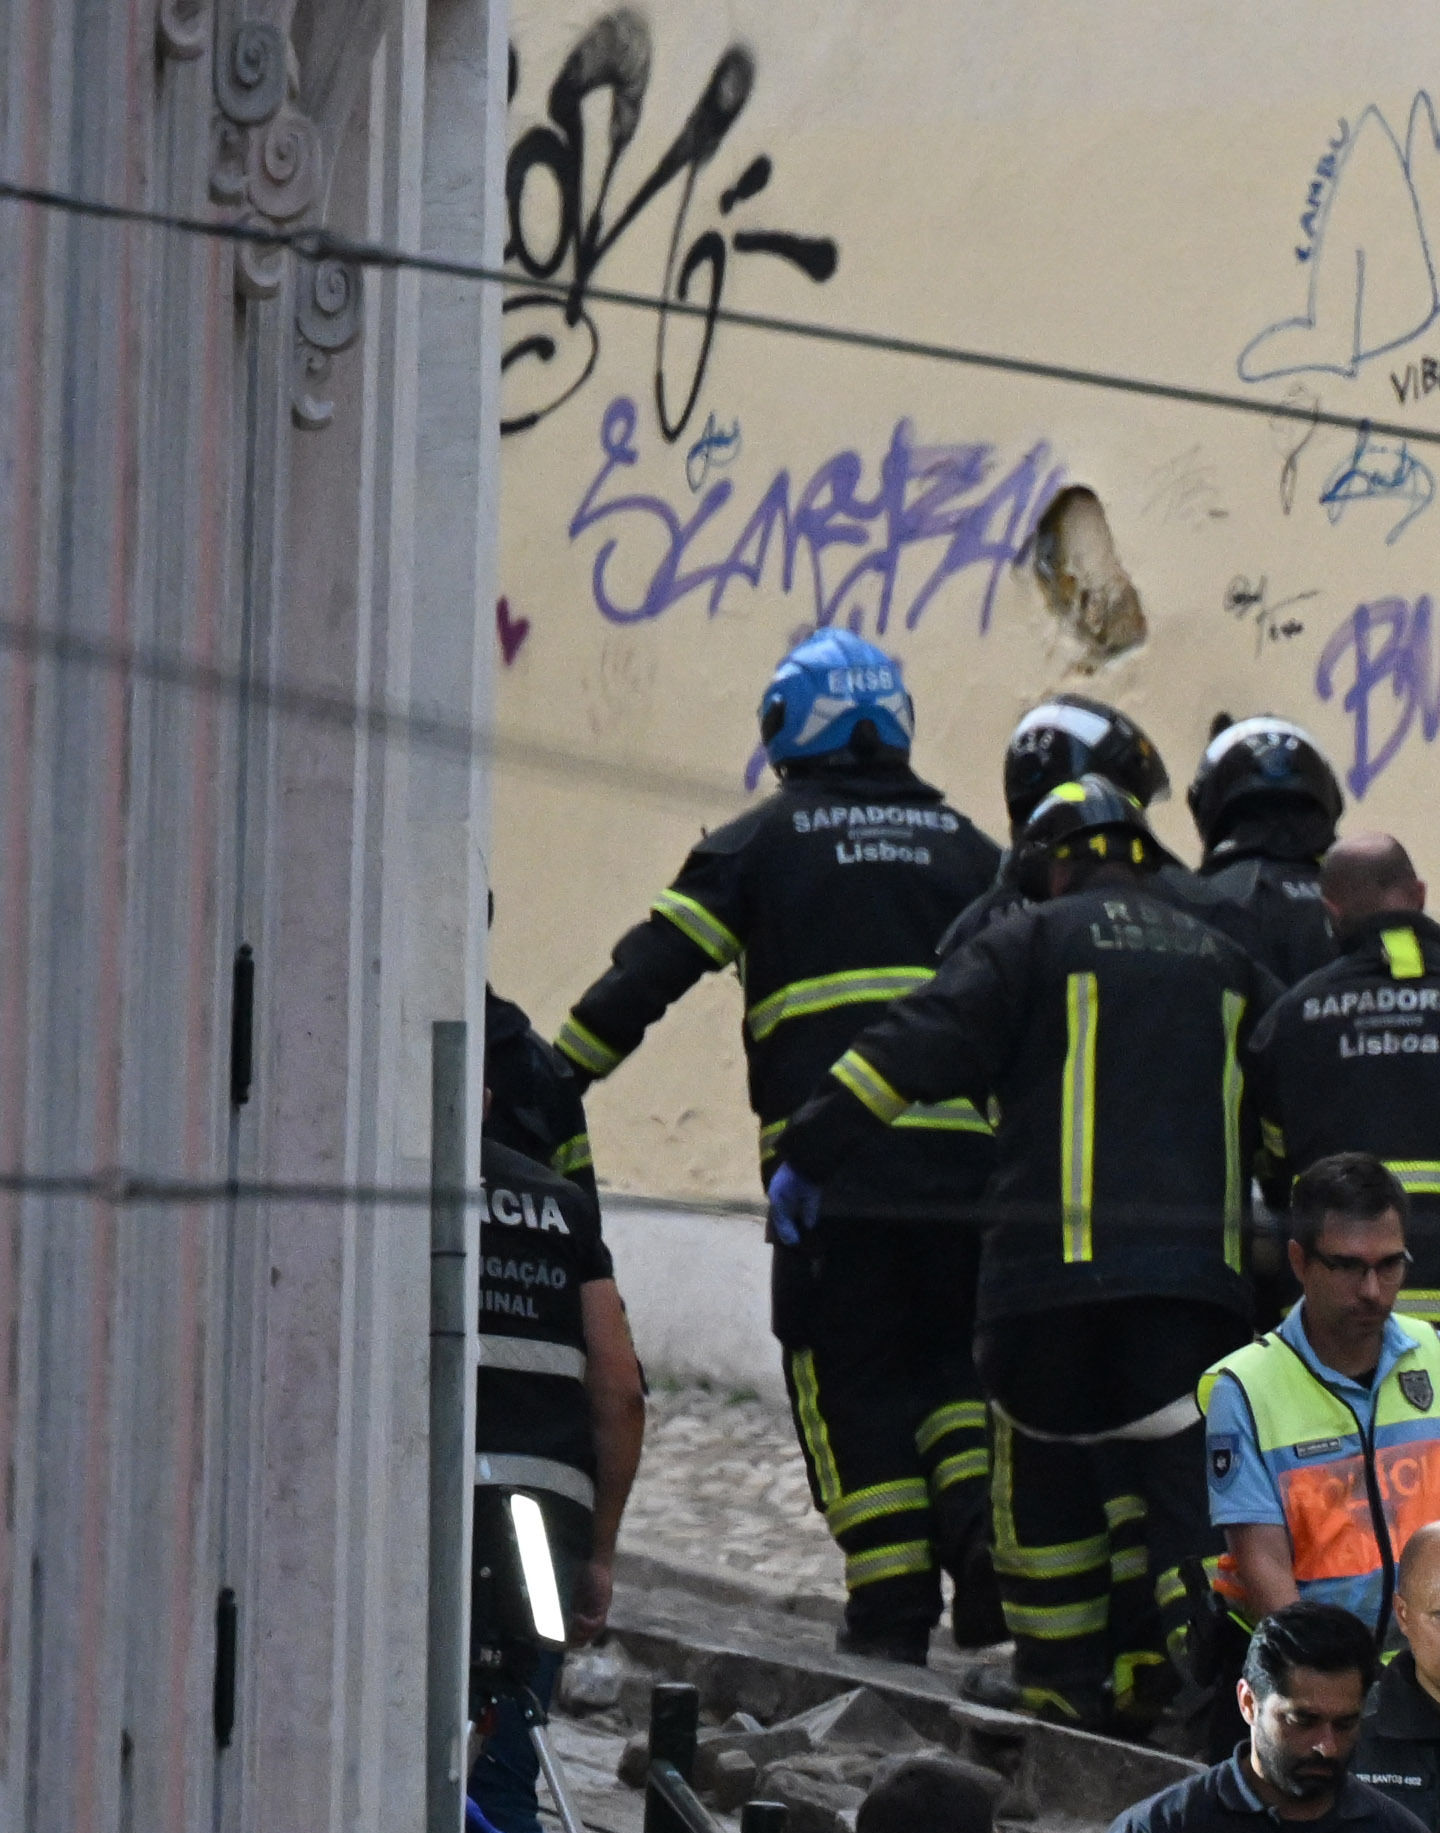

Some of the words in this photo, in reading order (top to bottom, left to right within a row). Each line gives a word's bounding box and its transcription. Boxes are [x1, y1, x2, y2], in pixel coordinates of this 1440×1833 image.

[792, 806, 959, 833] SAPADORES
[835, 842, 931, 866] Lisboa
[1339, 1031, 1440, 1058] Lisboa
